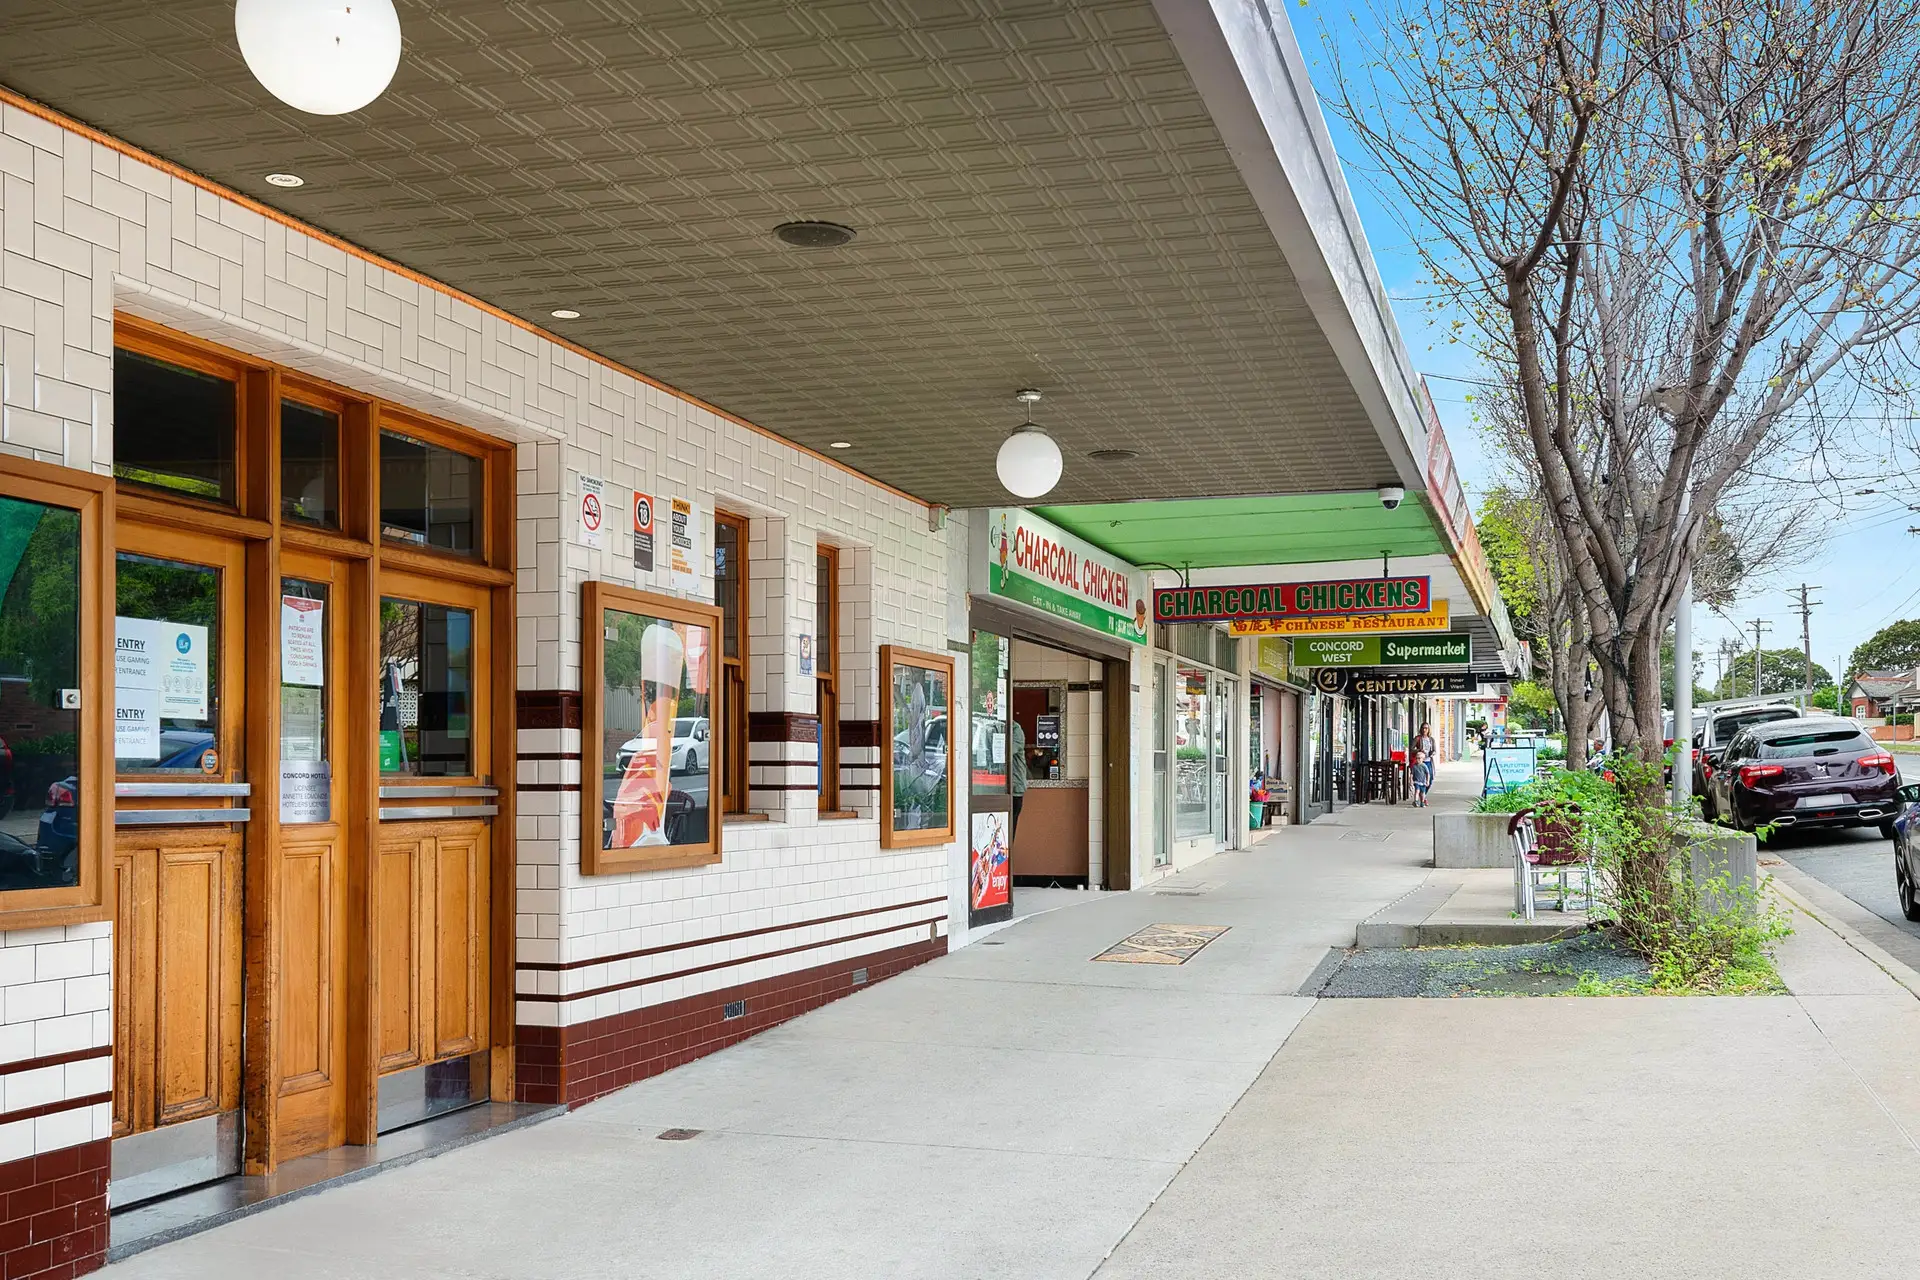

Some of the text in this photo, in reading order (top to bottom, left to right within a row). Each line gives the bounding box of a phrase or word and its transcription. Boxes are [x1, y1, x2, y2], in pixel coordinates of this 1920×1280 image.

[640, 508, 648, 524] 18
[673, 513, 686, 524] ABOUT
[673, 525, 684, 534] YOUR
[673, 536, 691, 547] CHOICES
[1015, 526, 1128, 609] CHARCOAL CHICKEN
[1159, 580, 1420, 617] CHARCOAL CHICKENS
[1286, 616, 1446, 631] CHINESE RESTAURANT
[118, 638, 146, 650] ENTRY
[1309, 641, 1364, 652] CONCORD
[1387, 641, 1466, 661] Supermarket
[127, 656, 150, 664] GAMING
[1322, 653, 1352, 662] WEST
[118, 668, 146, 676] ENTRANCE
[1324, 672, 1337, 686] 21
[1356, 678, 1444, 693] CENTURY 21
[117, 708, 145, 718] ENTRY
[992, 876, 1008, 890] enjoy
